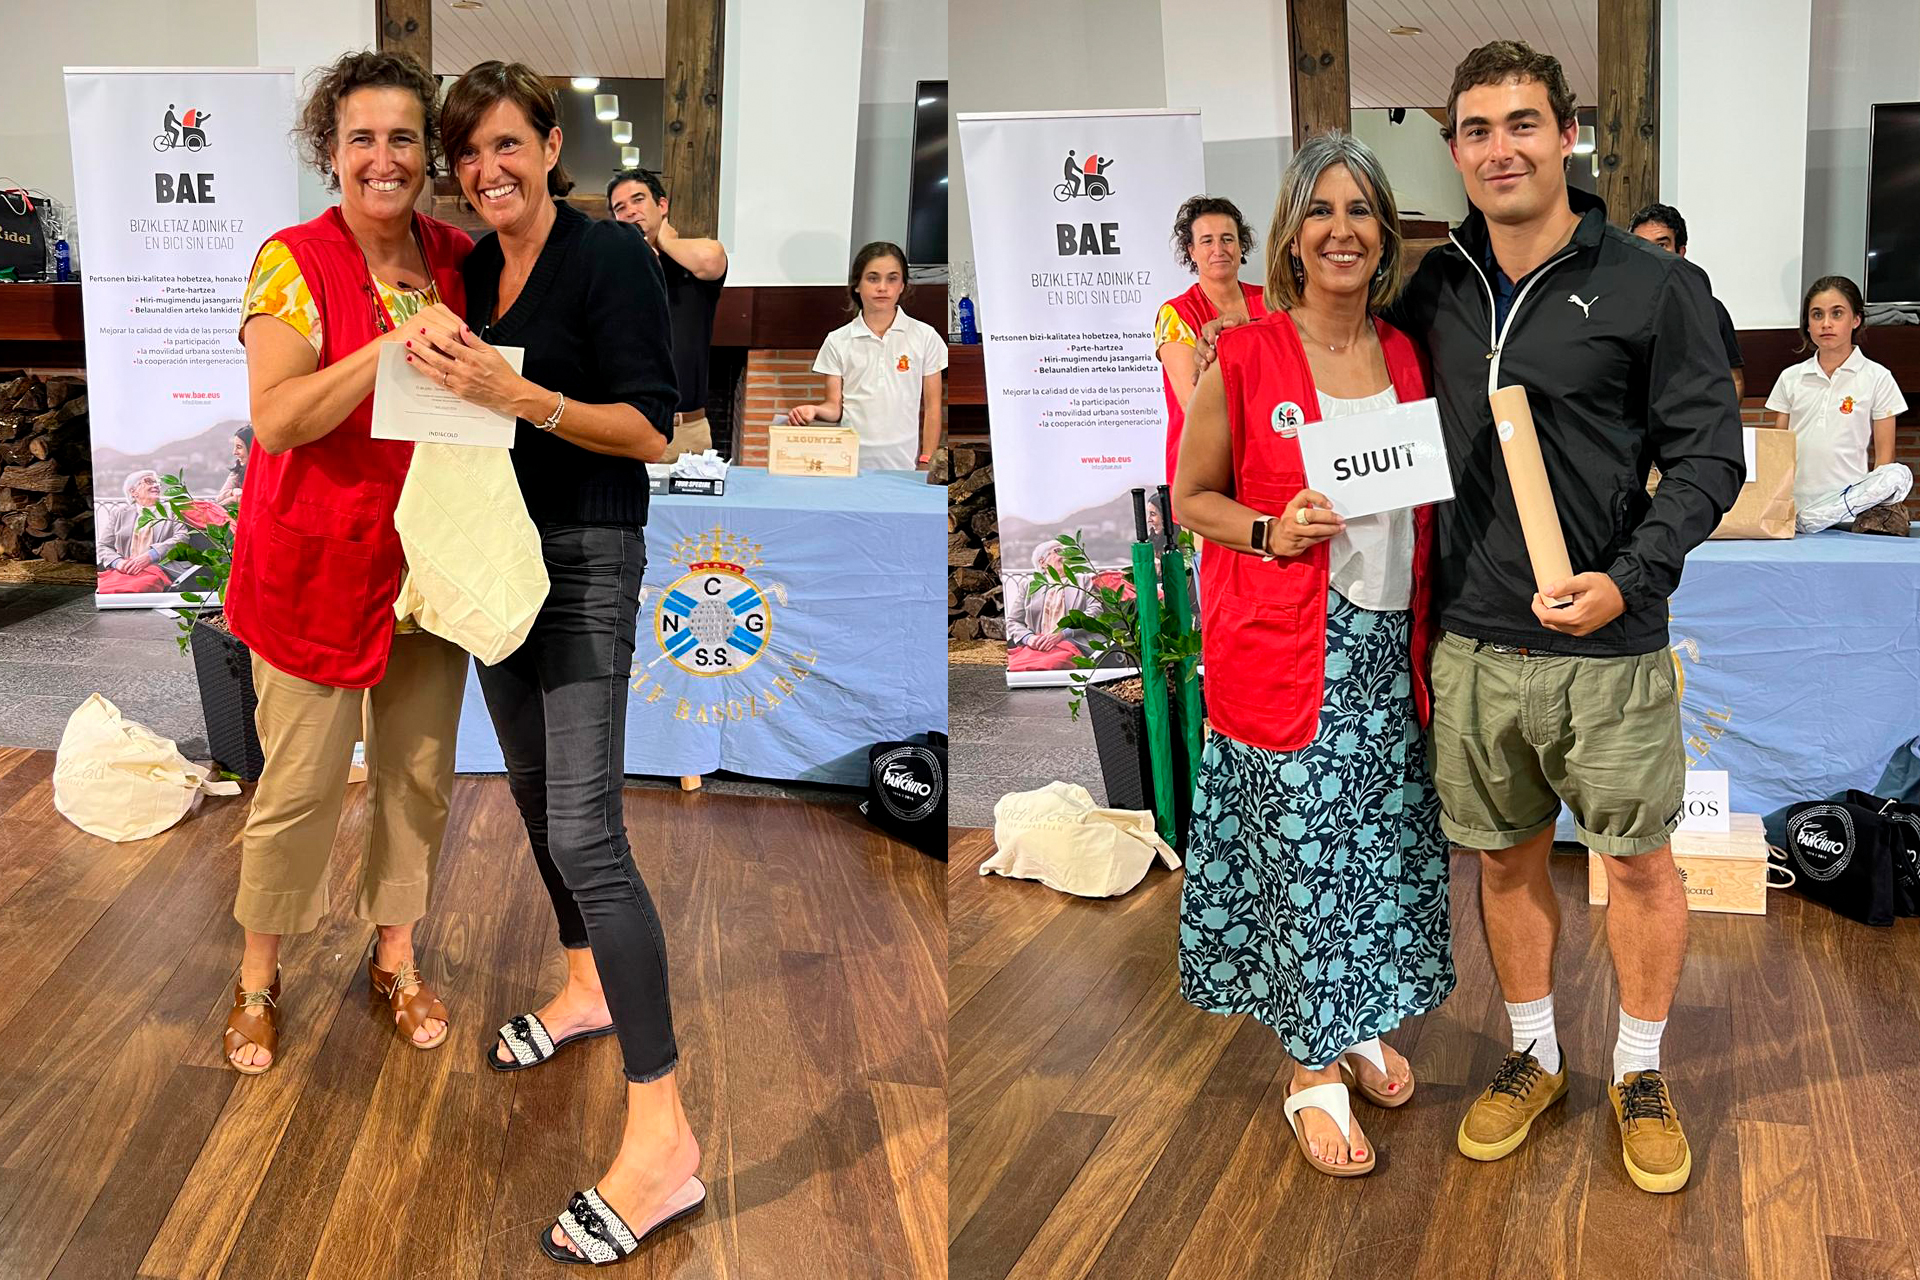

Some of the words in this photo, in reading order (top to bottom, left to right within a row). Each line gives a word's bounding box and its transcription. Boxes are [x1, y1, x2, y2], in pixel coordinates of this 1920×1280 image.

[155, 173, 216, 204] BAE
[130, 219, 189, 233] BIZIKLETAZ
[192, 219, 228, 233] ADINIK
[231, 219, 244, 233] EZ
[145, 236, 160, 250] EN
[163, 236, 183, 250] BICI
[186, 236, 204, 250] SIN
[207, 236, 234, 250] EDAD
[1056, 222, 1121, 256] BAE
[176, 276, 213, 284] hobetzea,
[1031, 272, 1094, 288] BIZIKLETAZ
[1097, 271, 1134, 286] ADINIK
[1137, 271, 1151, 286] EZ
[140, 297, 201, 305] Hiri-mugimendu
[202, 297, 242, 305] jasangarria
[1048, 291, 1063, 306] EN
[1067, 290, 1088, 305] BICI
[1091, 290, 1109, 304] SIN
[1113, 289, 1142, 304] EDAD
[99, 327, 127, 336] Mejorar
[990, 334, 1028, 342] Pertsonen
[1029, 333, 1081, 341] bizi-kalitatea
[1082, 333, 1121, 341] hobetzea,
[175, 338, 221, 346] participación
[1071, 344, 1124, 352] Parte-hartzea
[144, 358, 188, 366] cooperación
[1044, 355, 1108, 364] Hiri-mugimendu
[1109, 354, 1152, 363] jasangarria
[1039, 366, 1090, 374] Belaunaldien
[1002, 388, 1031, 397] Mejorar
[1041, 387, 1068, 395] calidad
[1098, 386, 1108, 394] de
[1121, 387, 1154, 395] personas
[1082, 398, 1130, 407] participación
[1093, 408, 1119, 416] urbana
[1120, 407, 1158, 415] sostenible
[1050, 419, 1097, 428] cooperación
[1098, 418, 1162, 427] intergeneracional
[1081, 455, 1132, 464] www.bae.eus
[1333, 443, 1416, 481] SUUIT
[703, 577, 722, 596] C
[662, 615, 679, 633] N
[744, 613, 764, 633] G
[695, 648, 732, 667] S.S.
[882, 770, 931, 797] PANCHITO
[1682, 800, 1719, 817] OS
[1797, 830, 1844, 855] PANCHITO
